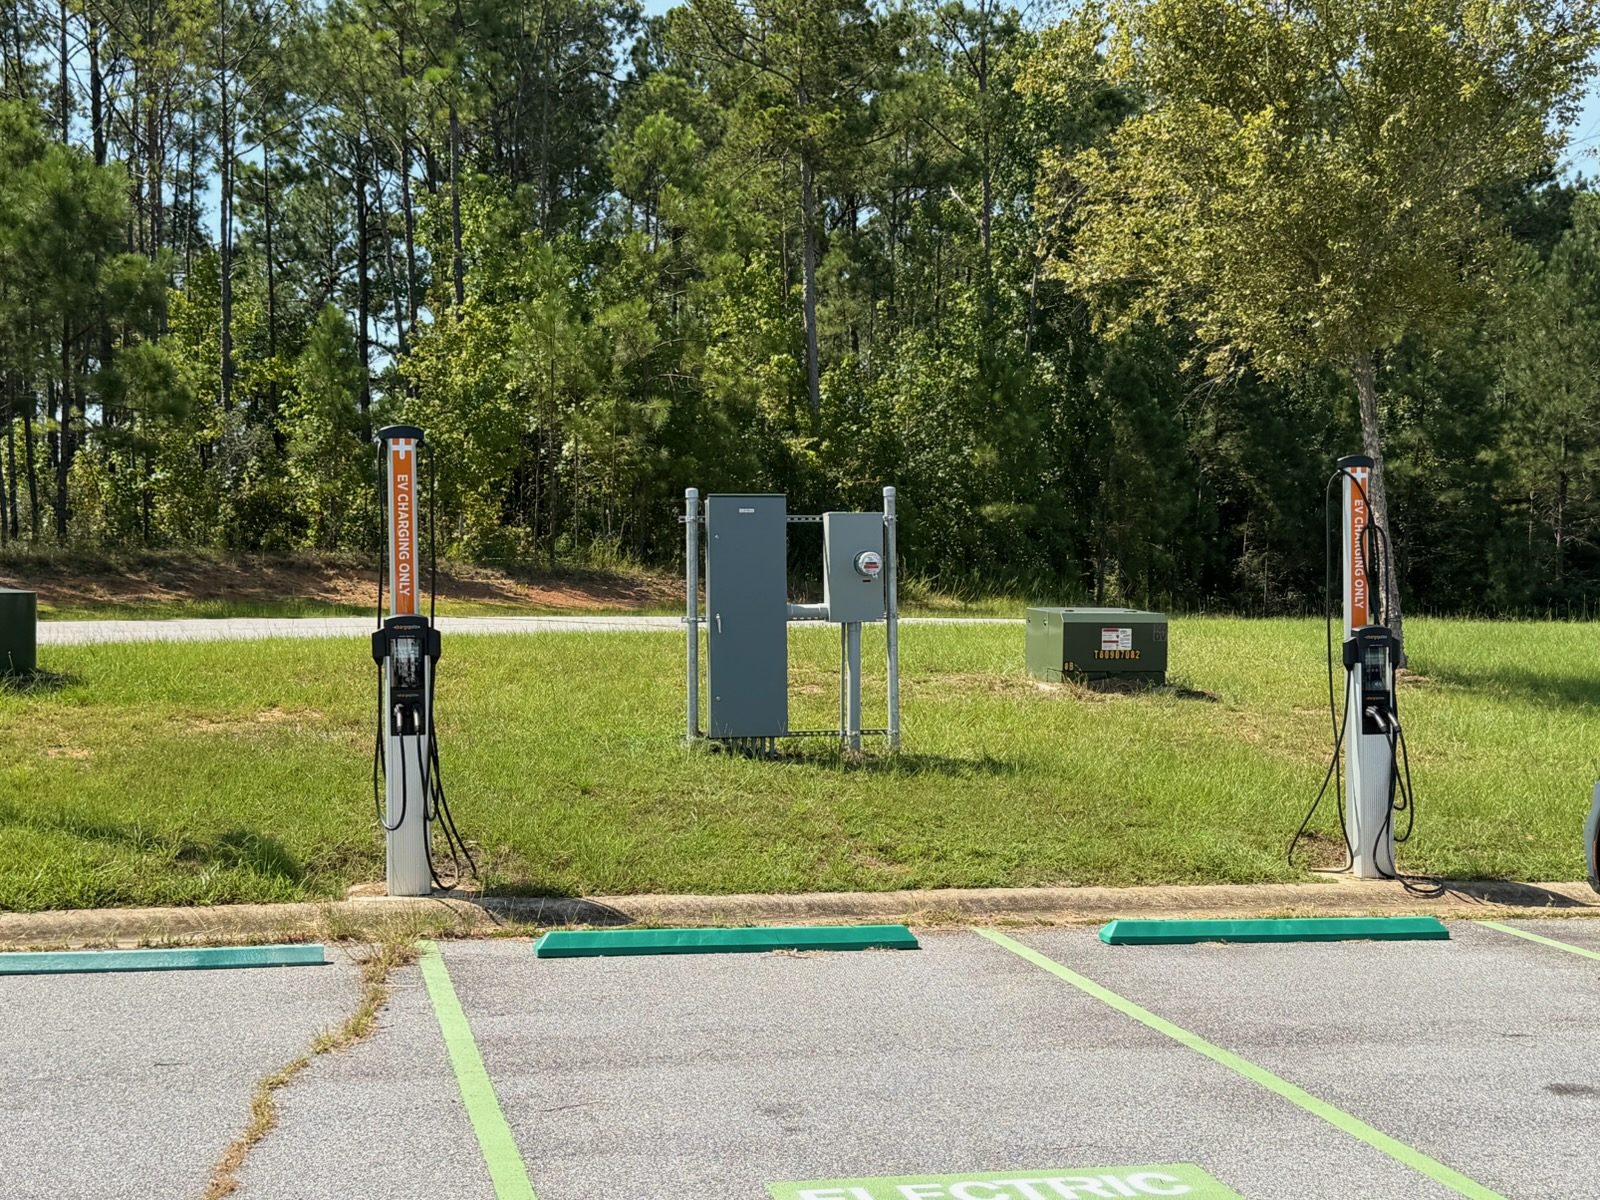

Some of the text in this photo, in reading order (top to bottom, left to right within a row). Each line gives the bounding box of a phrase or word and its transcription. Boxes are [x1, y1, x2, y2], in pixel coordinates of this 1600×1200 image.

[1354, 499, 1364, 514] EV
[397, 474, 410, 596] EV CHARGING ONLY
[1354, 578, 1364, 609] ONLY
